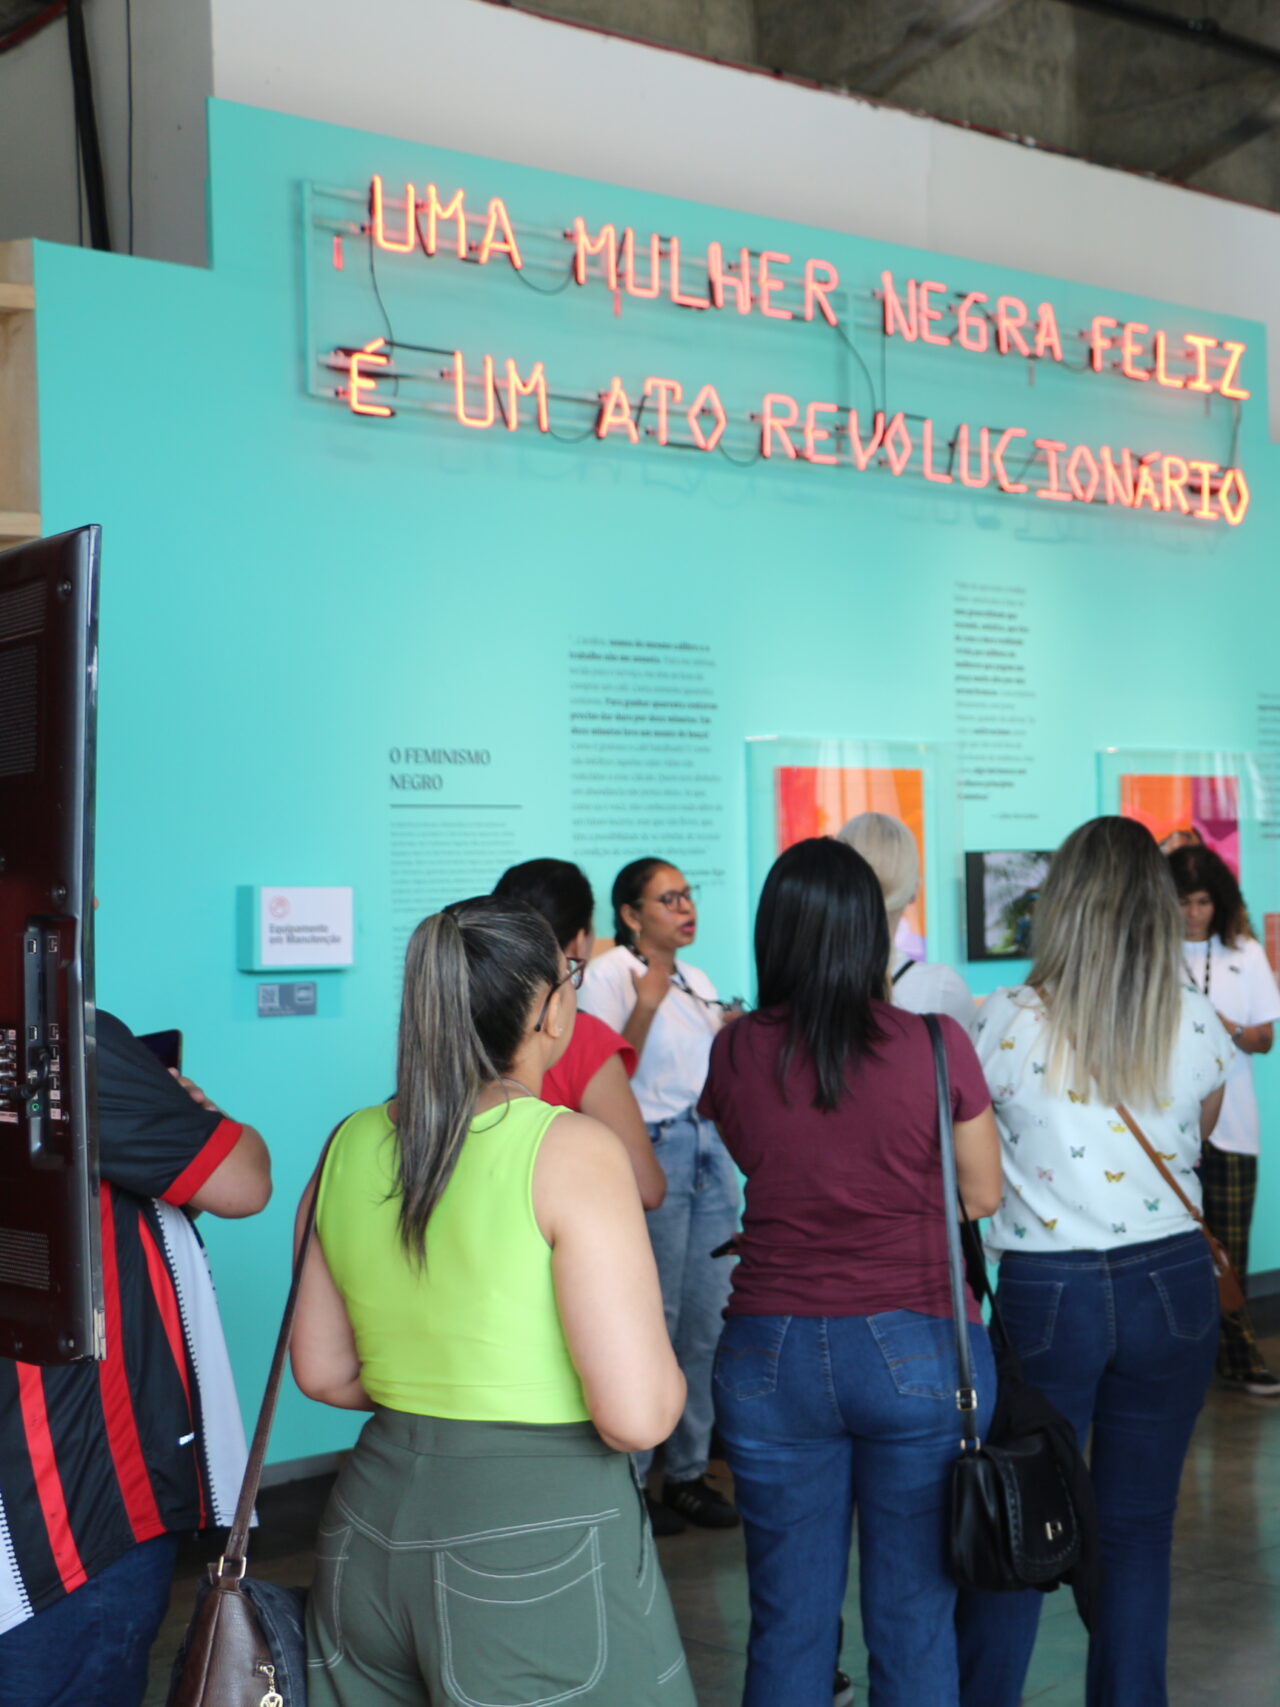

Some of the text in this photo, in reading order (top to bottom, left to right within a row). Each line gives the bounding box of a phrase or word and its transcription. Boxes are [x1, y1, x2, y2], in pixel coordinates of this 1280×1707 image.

[372, 174, 1251, 400] UMA MULHER NEGRA FELIZ
[350, 338, 1250, 526] É UM ATO REVOLUCIONÁRIO
[389, 747, 491, 766] O FEMINISMO
[389, 773, 443, 790] NEGRO
